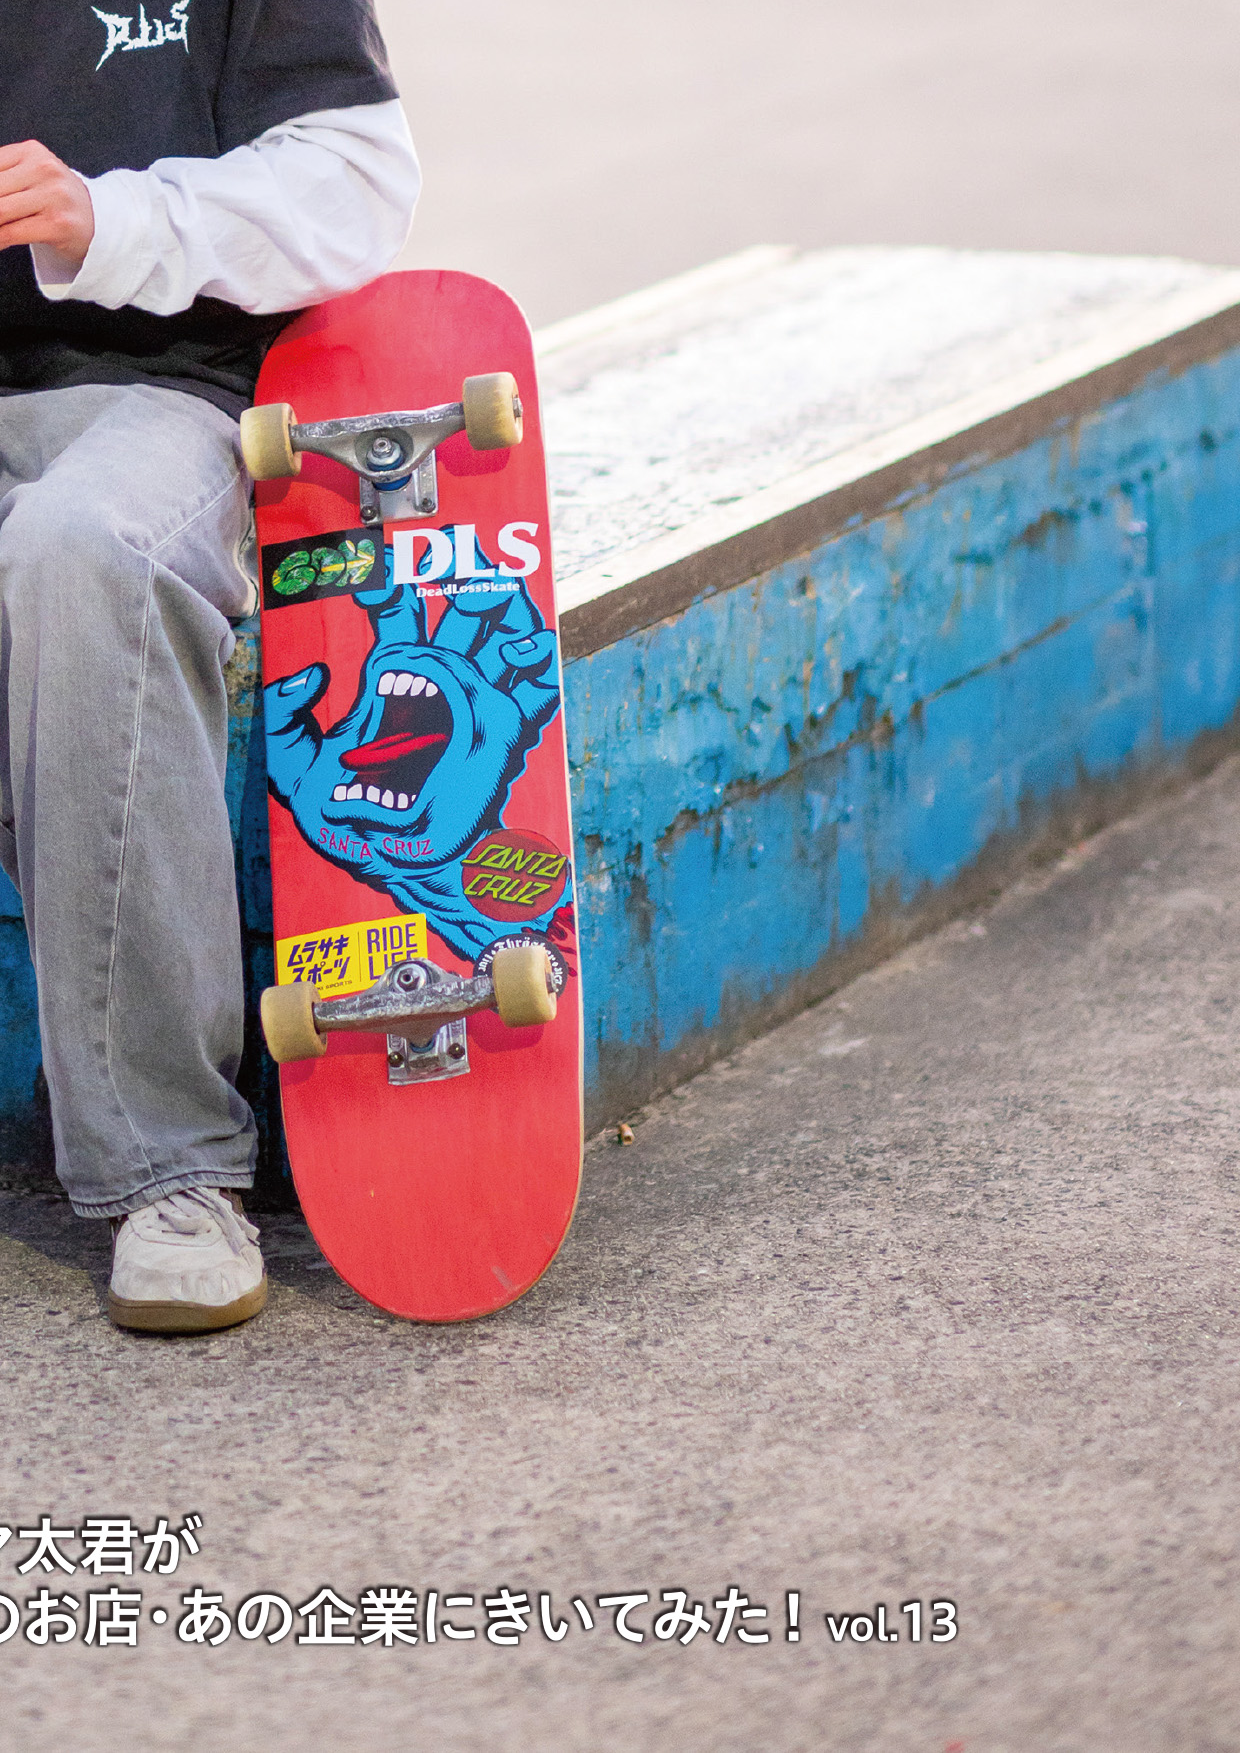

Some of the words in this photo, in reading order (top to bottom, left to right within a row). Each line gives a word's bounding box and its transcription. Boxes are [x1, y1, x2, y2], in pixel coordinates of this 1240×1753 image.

[392, 522, 541, 585] DLS
[416, 581, 521, 599] DeadLossSkate
[317, 827, 373, 860] SANTA
[382, 836, 435, 859] CRUZ
[461, 844, 567, 879] SANTA
[463, 873, 551, 905] CRUZ
[287, 934, 350, 968] ムラサキ
[366, 922, 419, 955] RIDE
[291, 956, 351, 984] スポーツ
